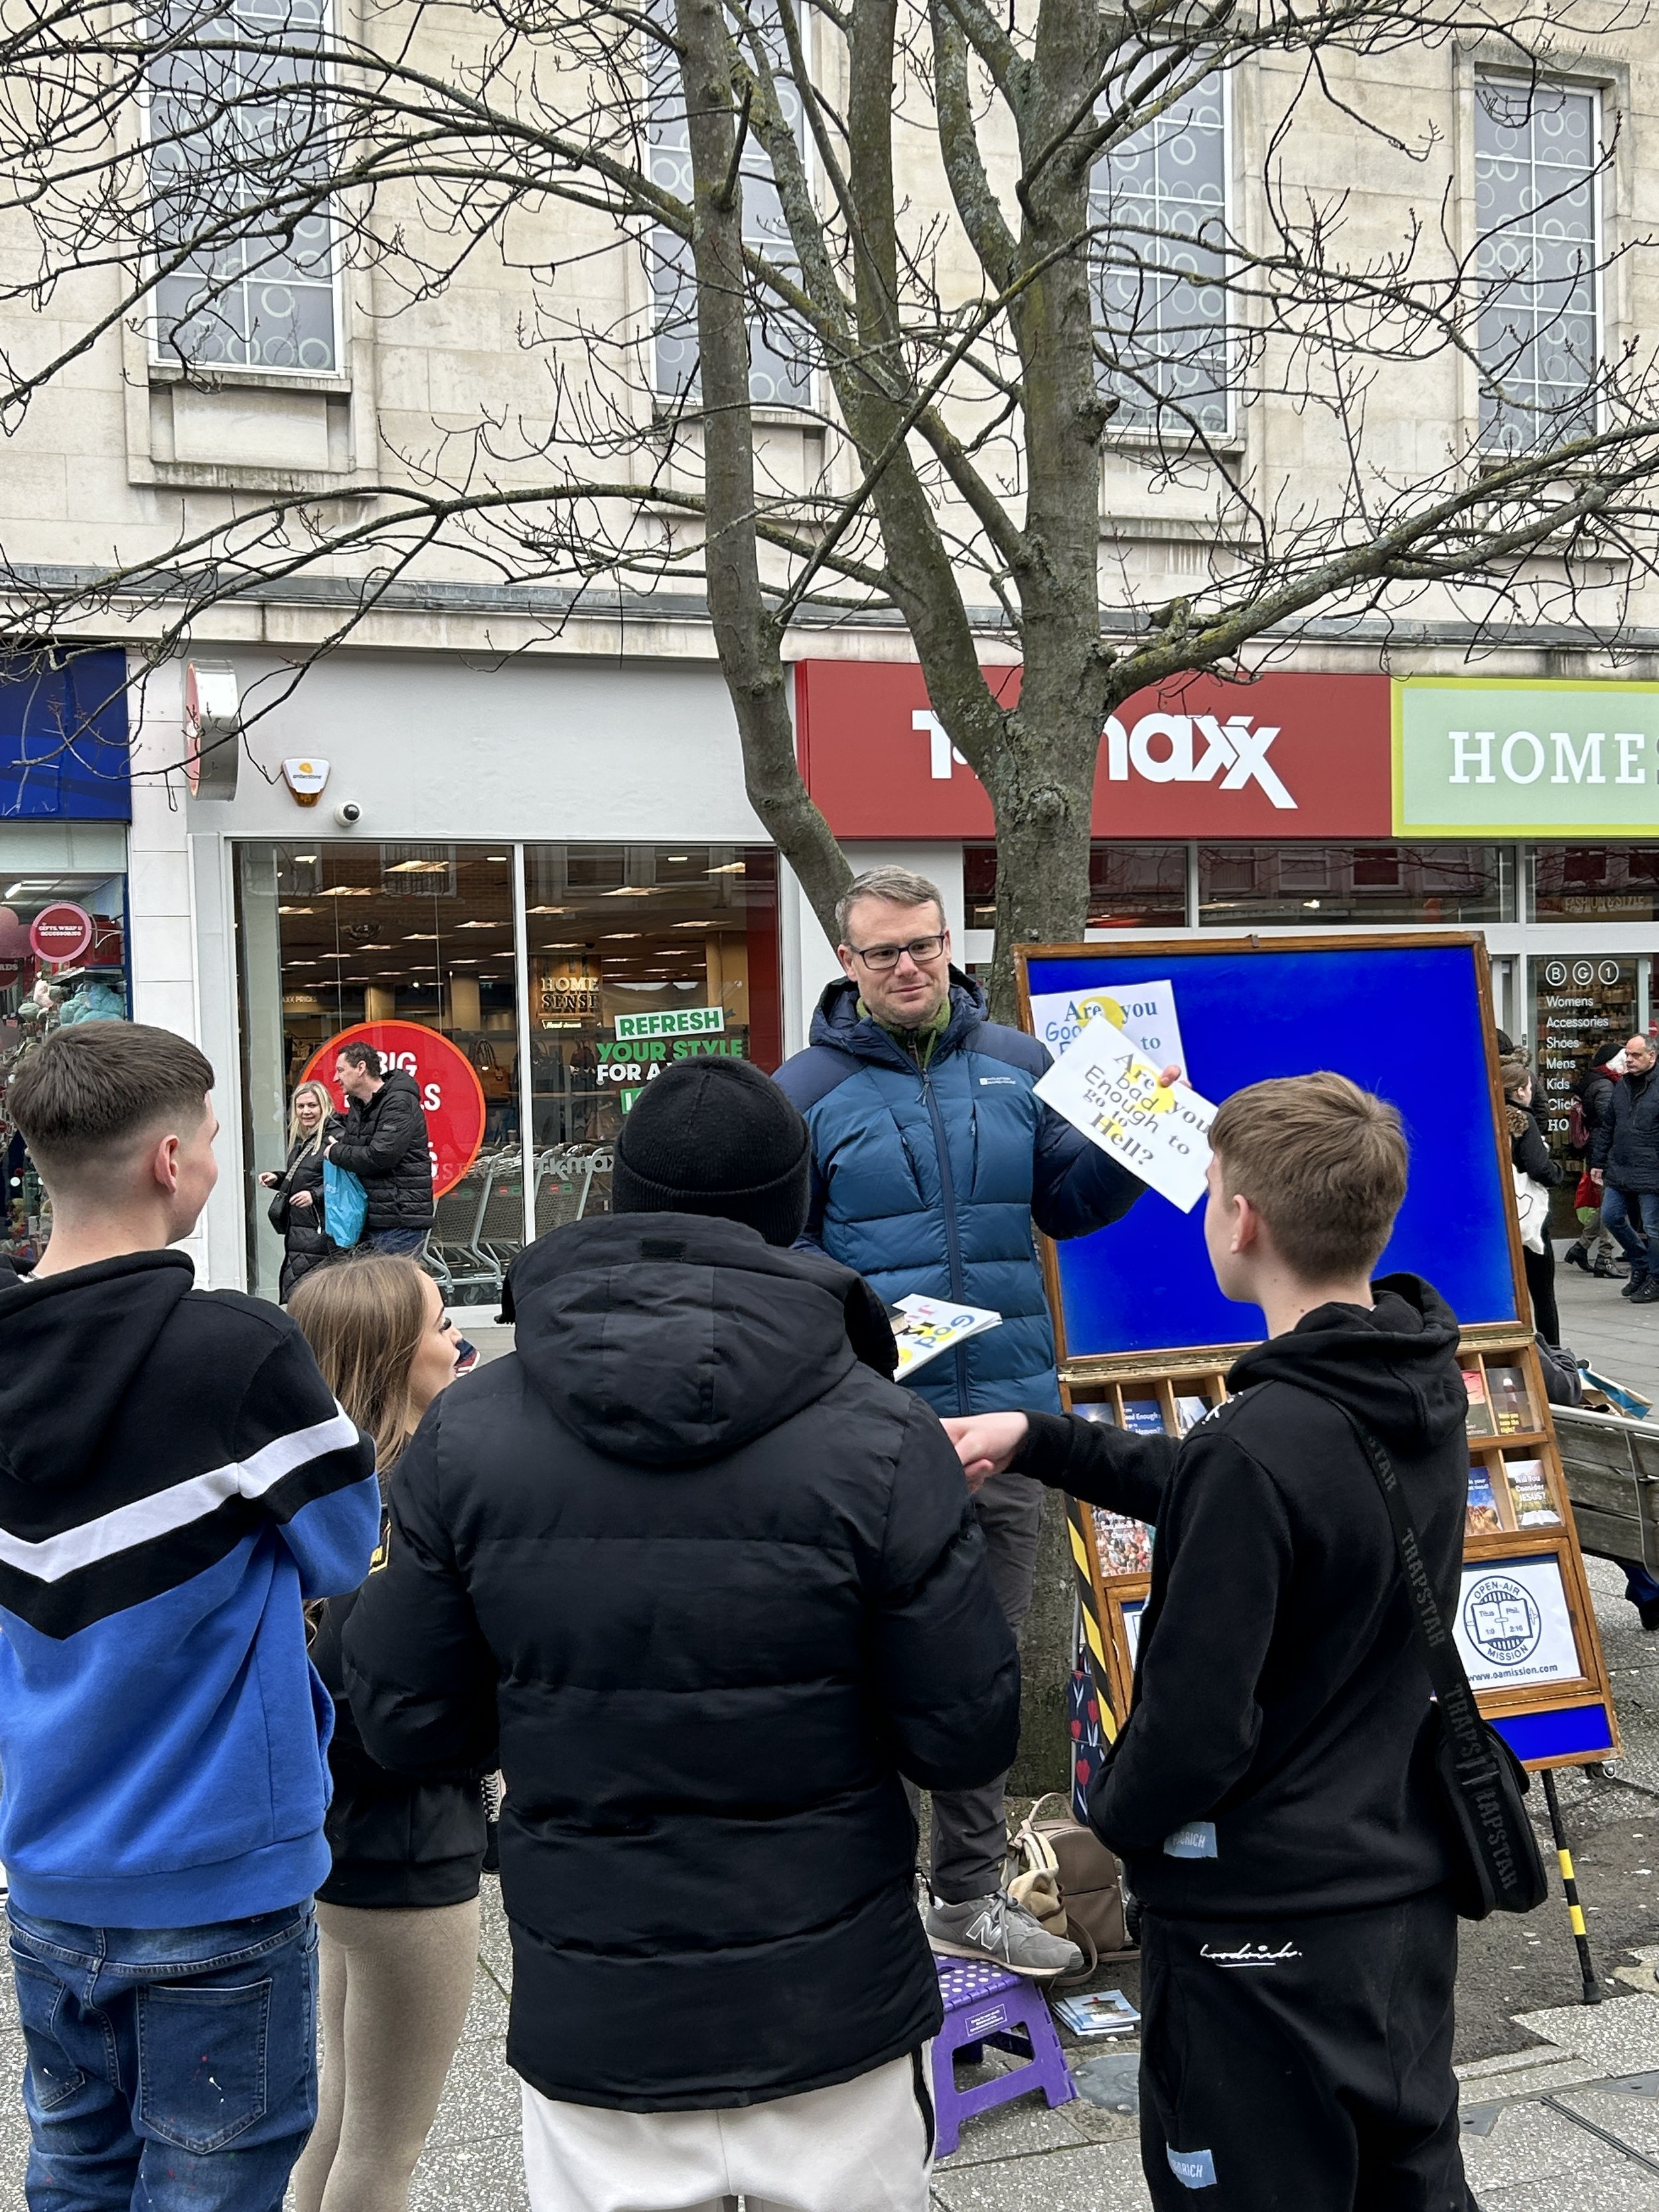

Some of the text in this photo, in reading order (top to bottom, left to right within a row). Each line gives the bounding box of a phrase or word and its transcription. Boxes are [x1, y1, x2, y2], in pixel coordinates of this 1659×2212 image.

[1448, 731, 1659, 784] HOME
[541, 976, 599, 992] HOME
[1064, 1000, 1158, 1023] Are you
[1545, 995, 1594, 1007] Womens
[618, 1010, 720, 1037] REFRESH
[1546, 1014, 1609, 1028] Accessories
[1045, 1021, 1161, 1051] Goo to
[1546, 1036, 1580, 1049] Shoes
[596, 1039, 743, 1063] YOUR STYLE
[597, 1063, 642, 1082] FOR
[1546, 1057, 1576, 1070] Mens
[1112, 1053, 1212, 1134] Are you
[1116, 1070, 1160, 1112] bad
[1546, 1077, 1571, 1090] Kids
[1082, 1088, 1128, 1128] go to
[1084, 1064, 1190, 1155] Enough to
[1090, 1111, 1155, 1165] Hell?
[1518, 1492, 1547, 1502] JESUS?
[1400, 1527, 1445, 1647] TRAPSTAR
[1473, 1580, 1520, 1599] OPEN-AIR
[1487, 1644, 1529, 1661] MISSION
